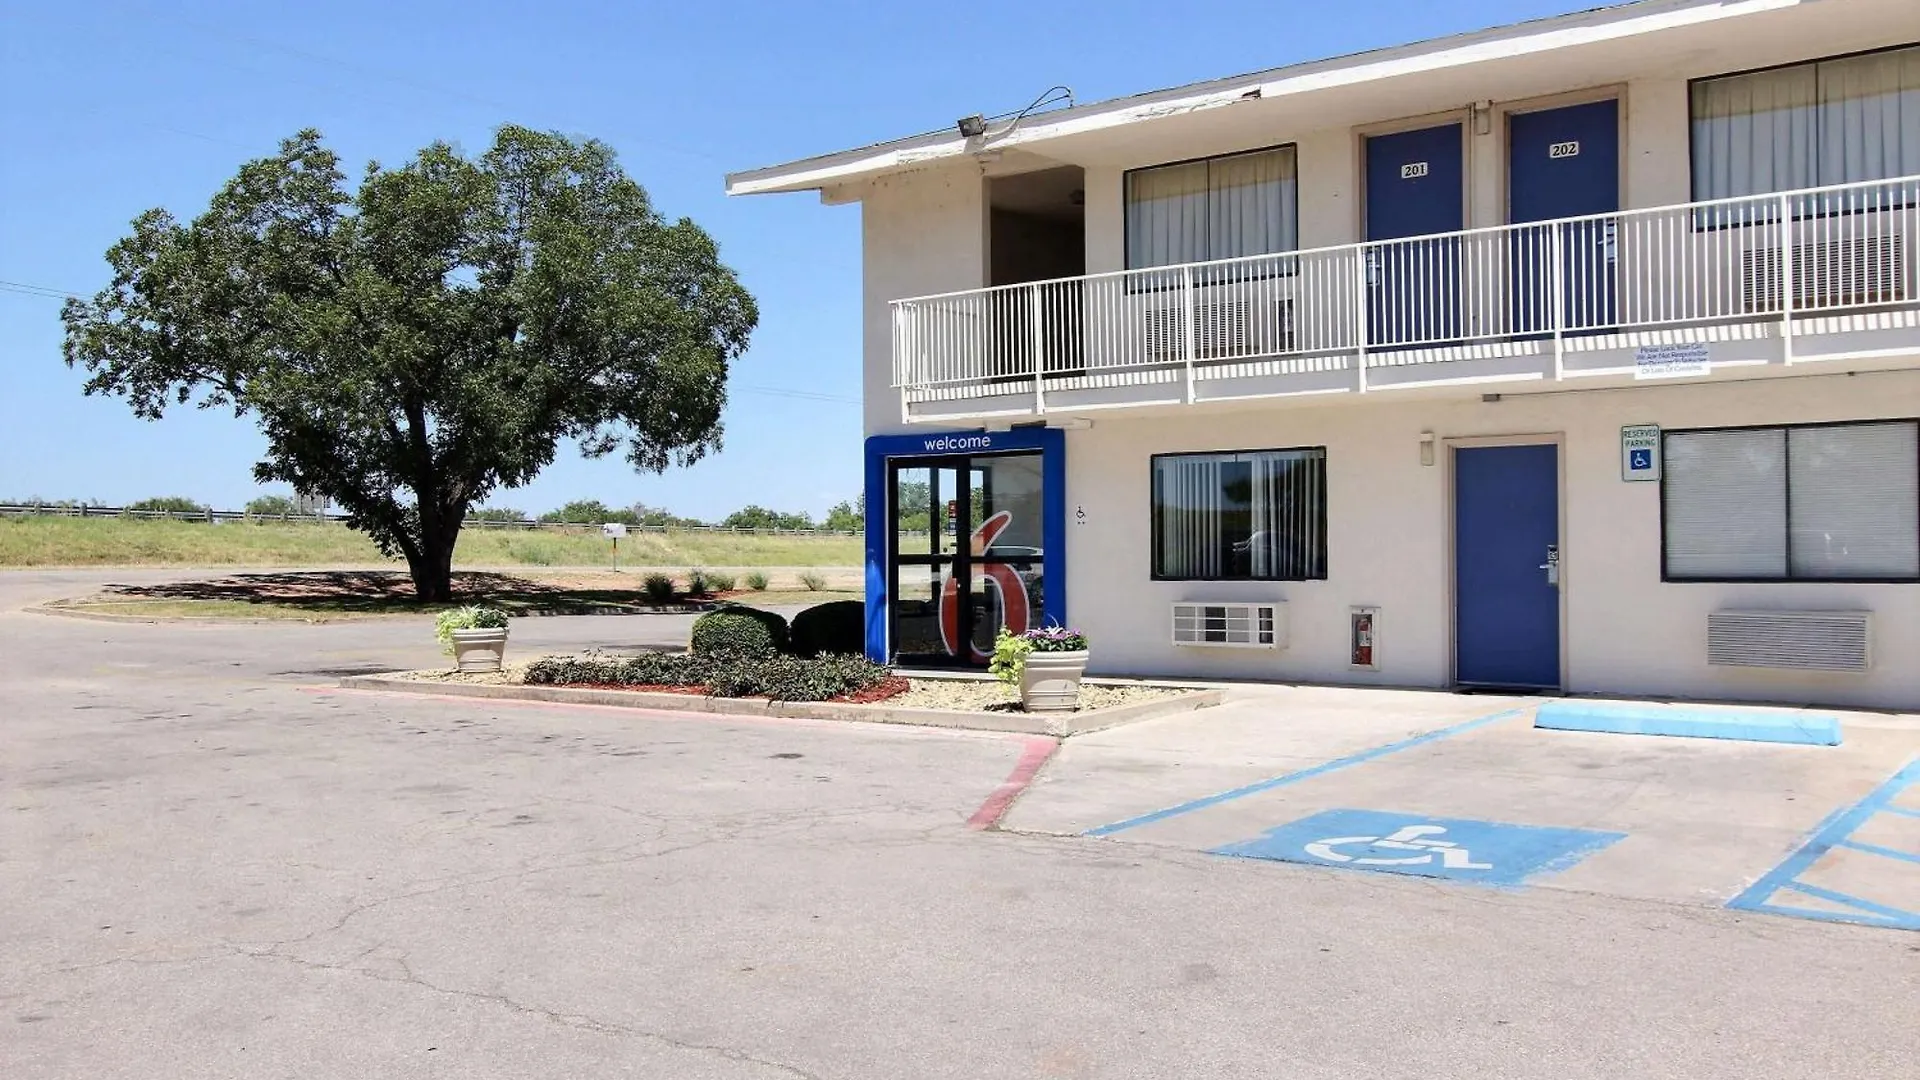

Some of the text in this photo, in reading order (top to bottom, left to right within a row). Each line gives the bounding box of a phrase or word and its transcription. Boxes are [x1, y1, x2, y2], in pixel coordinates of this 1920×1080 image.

[1553, 143, 1576, 156] 202
[1405, 164, 1425, 176] 201
[1624, 429, 1659, 438] RESERVED
[924, 435, 991, 451] welcome
[1625, 439, 1656, 447] PARKING
[939, 510, 1030, 665] 6
